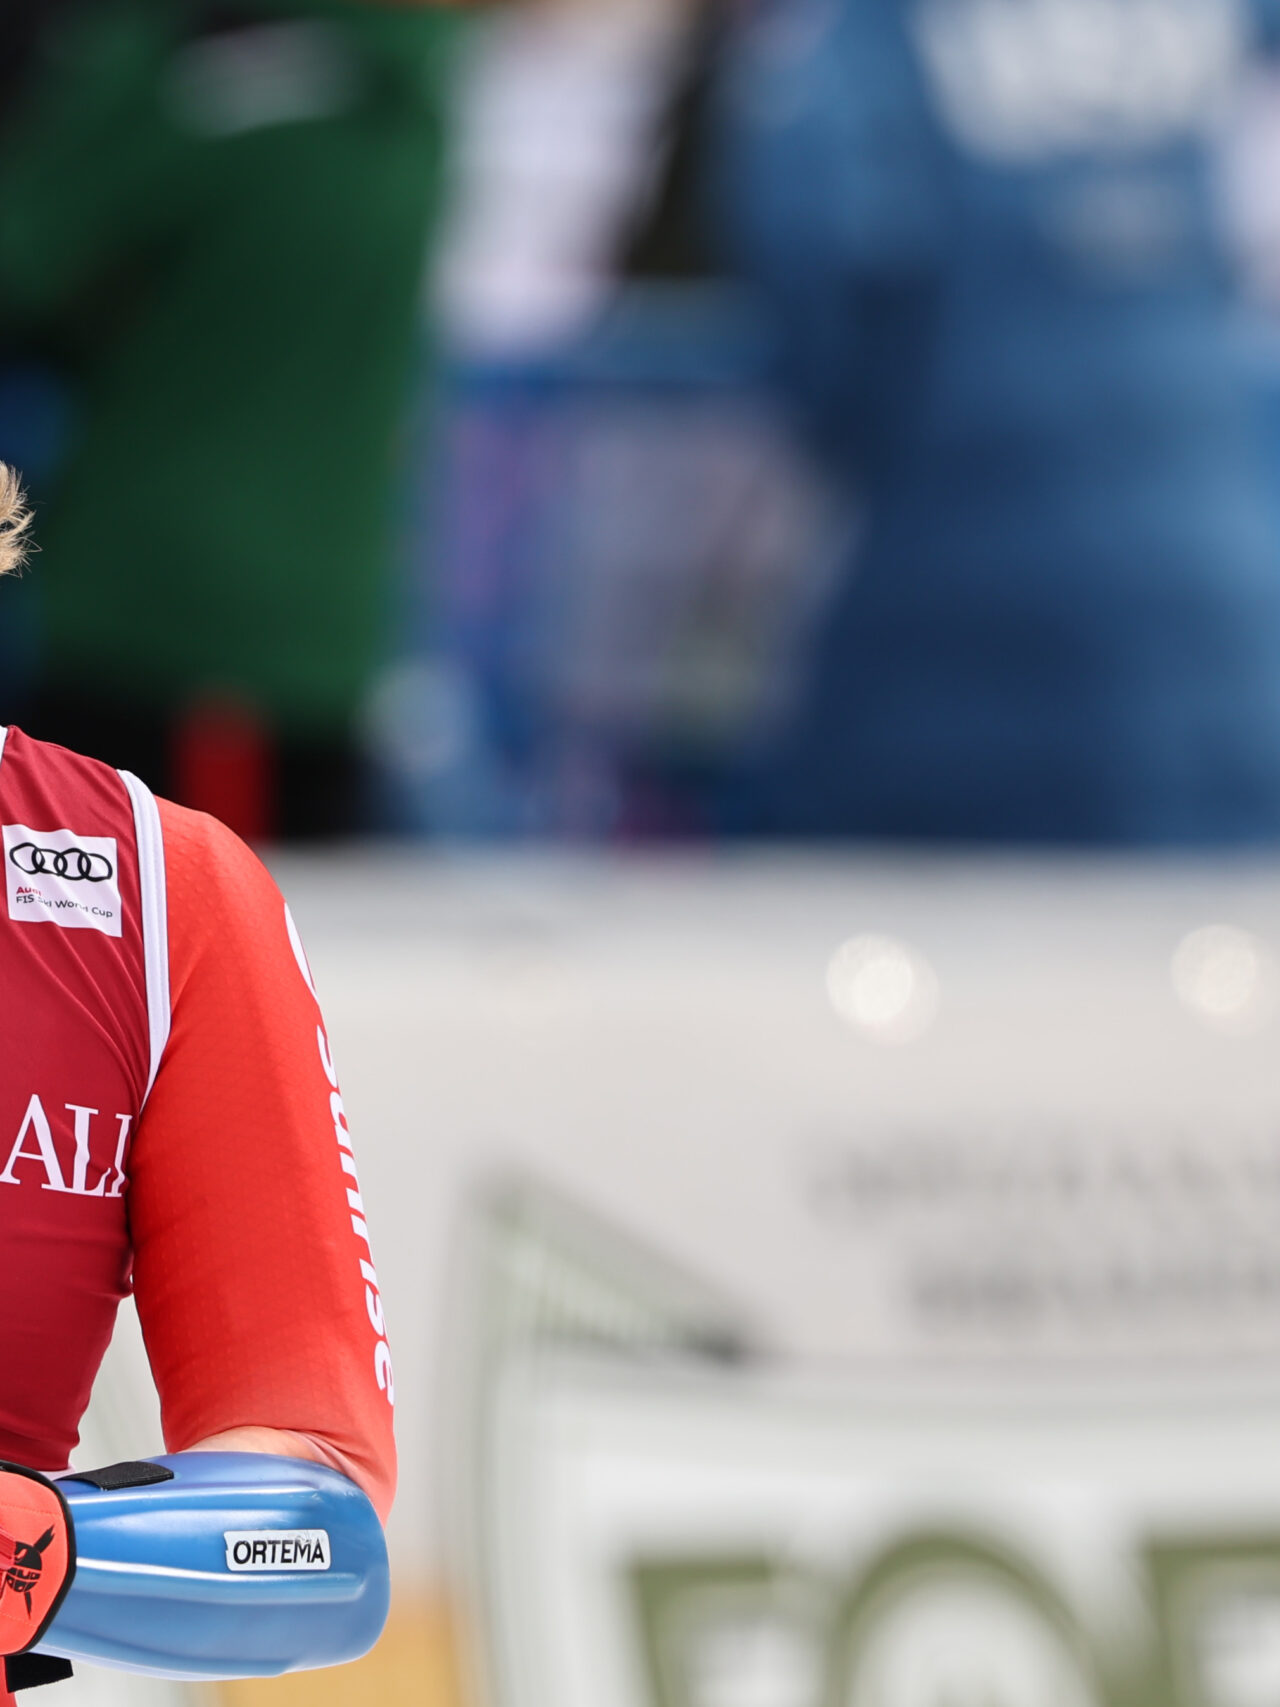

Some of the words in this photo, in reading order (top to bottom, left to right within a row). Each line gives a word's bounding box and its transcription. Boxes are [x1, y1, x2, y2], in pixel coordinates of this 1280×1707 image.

[16, 894, 34, 904] FIS
[54, 900, 89, 913] Word
[91, 906, 113, 918] Cup
[232, 1538, 325, 1565] ORTEMA
